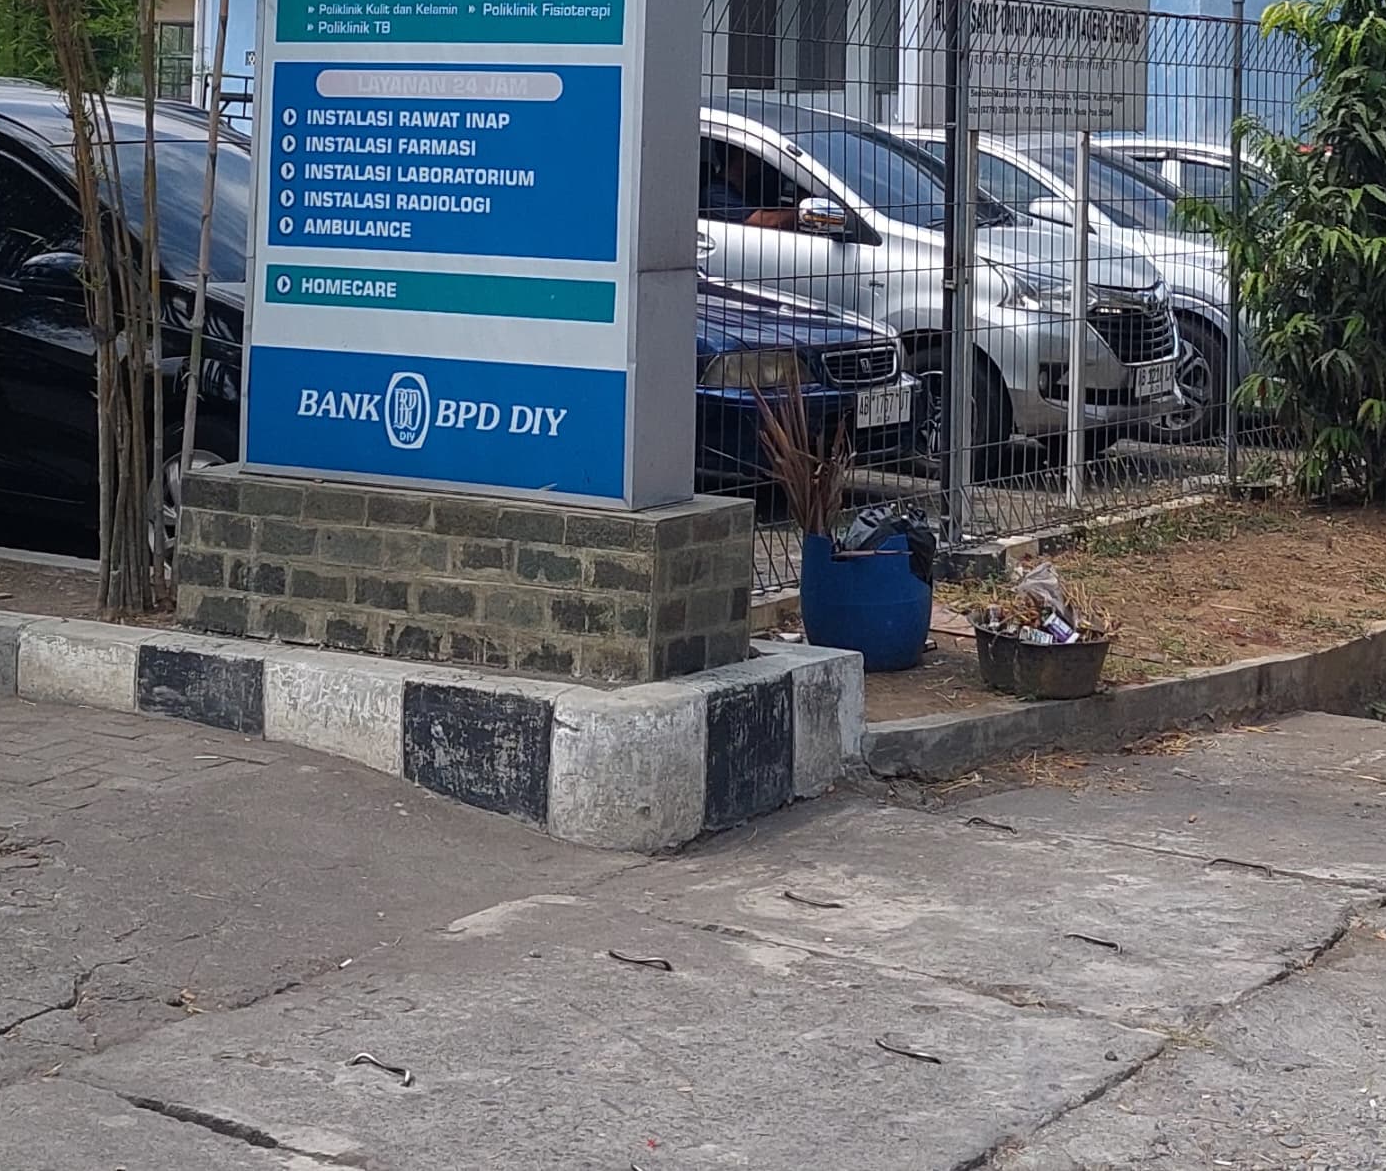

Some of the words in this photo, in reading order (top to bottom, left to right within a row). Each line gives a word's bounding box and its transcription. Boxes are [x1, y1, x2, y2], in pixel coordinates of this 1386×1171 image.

[319, 3, 363, 15] Poliklinik
[366, 3, 390, 15] Kulit
[393, 3, 412, 15] dan
[415, 3, 458, 15] Kelamin
[483, 3, 537, 16] Poliklinik
[542, 3, 611, 20] Fisioterapi
[318, 21, 370, 35] Poliklinik
[373, 21, 391, 34] TB
[358, 75, 446, 94] LAYANAN
[452, 77, 478, 94] 24
[485, 78, 529, 95] JAM
[306, 109, 393, 127] INSTALASI
[399, 111, 460, 128] RAWAT
[465, 112, 510, 129] INAP
[305, 136, 392, 154] INSTALASI
[398, 138, 476, 156] FARMASI
[304, 163, 391, 182] INSTALASI
[397, 166, 535, 187] LABORATORIUM
[303, 190, 391, 210] INSTALASI
[396, 193, 491, 214] RADIOLOGI
[303, 219, 412, 238] AMBULANCE
[300, 277, 397, 298] HOMECARE
[297, 389, 382, 422] BANK
[435, 399, 501, 431] BPD
[508, 404, 568, 436] DIY
[399, 431, 416, 442] DIY
